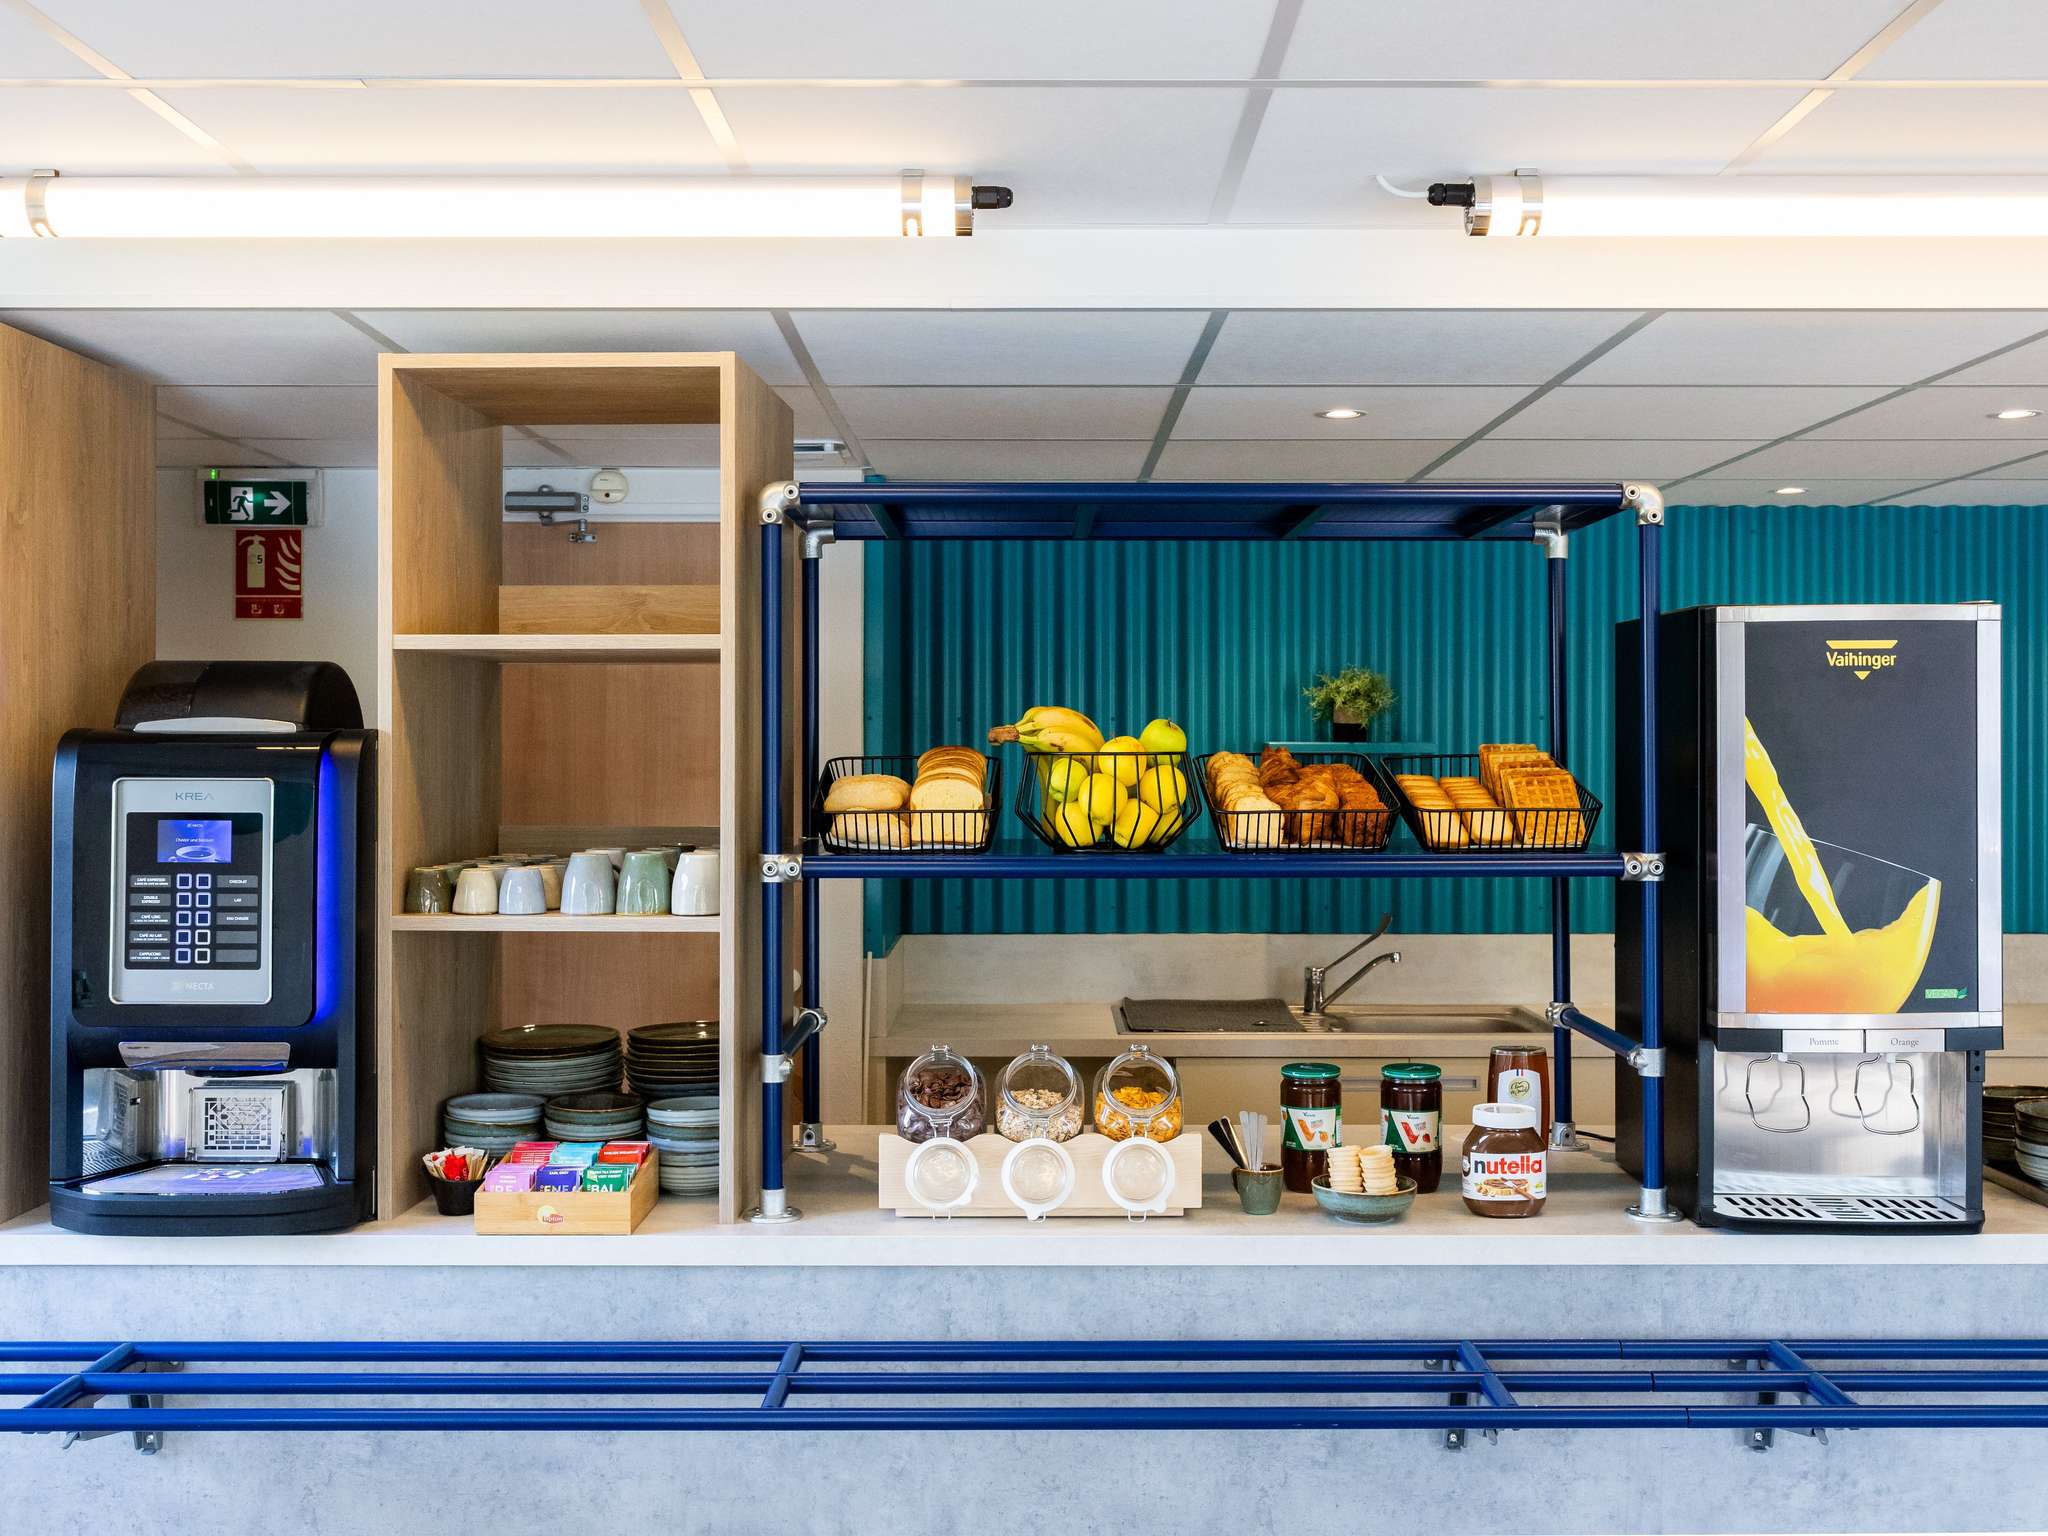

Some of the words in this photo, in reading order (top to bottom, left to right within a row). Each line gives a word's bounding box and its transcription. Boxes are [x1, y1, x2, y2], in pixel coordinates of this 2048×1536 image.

[256, 554, 263, 565] 5
[1826, 652, 1896, 669] Vaihinger
[1809, 1037, 1839, 1046] Pomme
[1890, 1037, 1919, 1048] Orange
[1474, 1155, 1542, 1175] nutella
